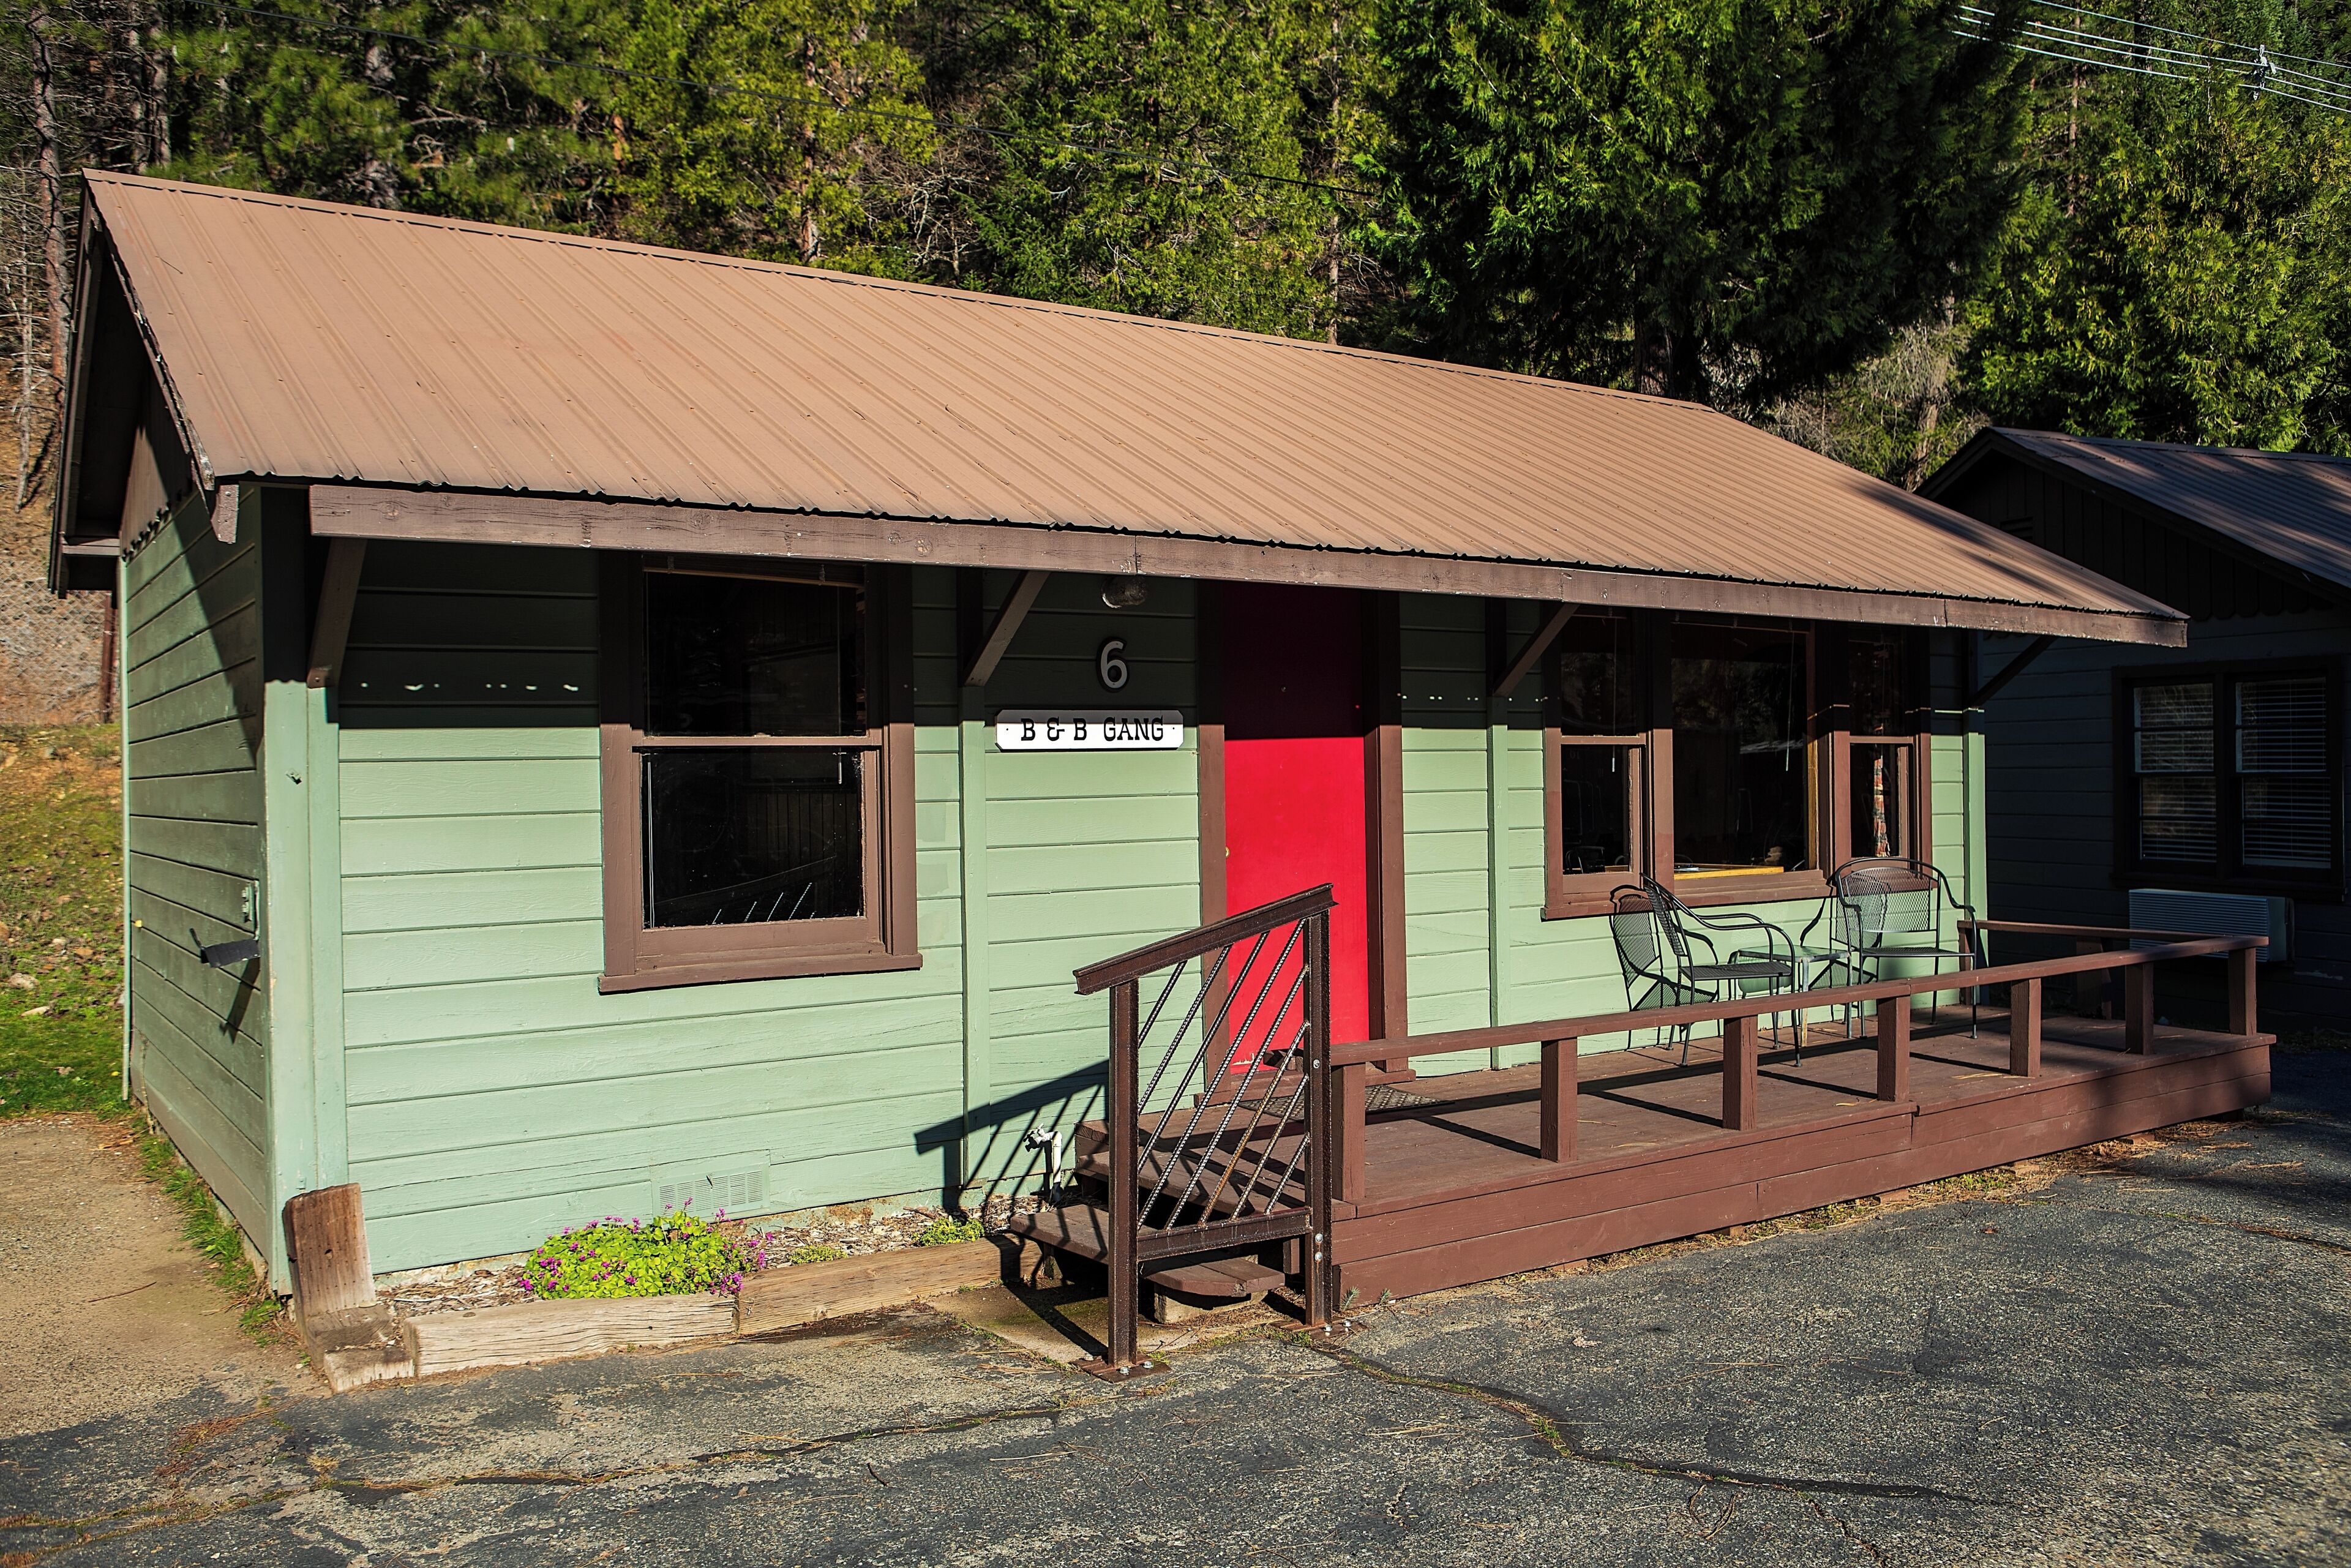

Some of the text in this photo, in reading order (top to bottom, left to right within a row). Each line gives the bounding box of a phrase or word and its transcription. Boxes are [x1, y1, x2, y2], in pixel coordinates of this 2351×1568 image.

[1100, 640, 1127, 689] 6
[1021, 716, 1163, 741] B & B GANG
